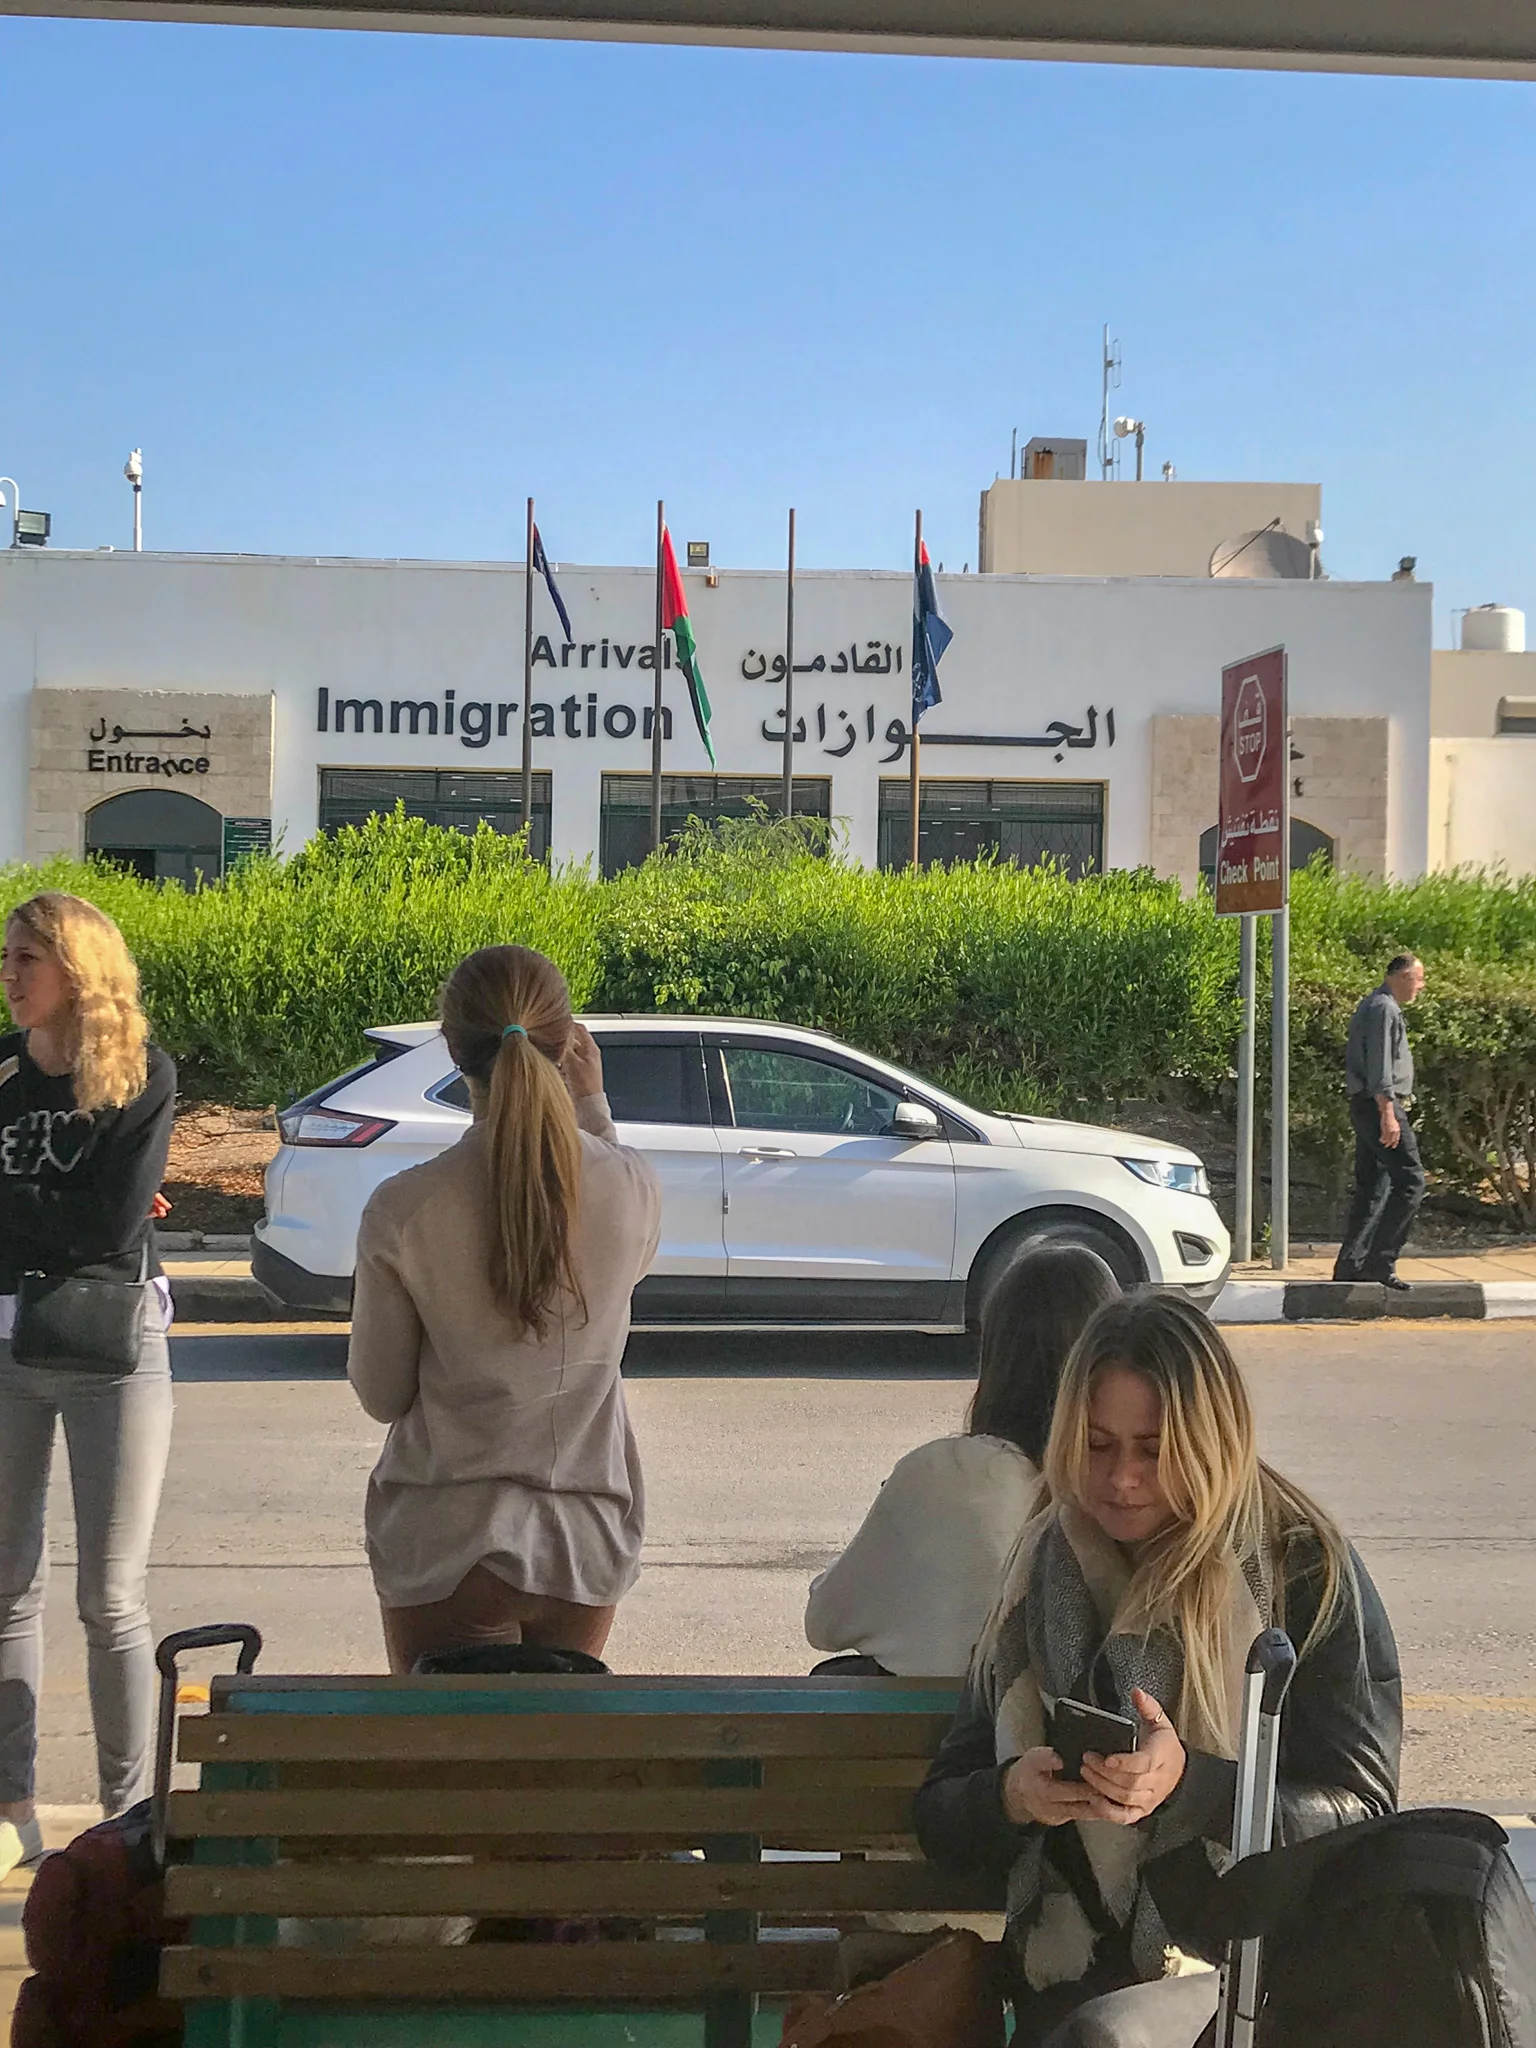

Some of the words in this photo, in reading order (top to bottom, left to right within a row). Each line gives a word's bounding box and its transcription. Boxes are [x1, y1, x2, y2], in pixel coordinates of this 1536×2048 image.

[317, 687, 673, 748] Immigration
[1239, 732, 1262, 756] STOP
[88, 749, 210, 778] Entrance
[1220, 858, 1249, 885] Check
[1254, 855, 1280, 882] Point
